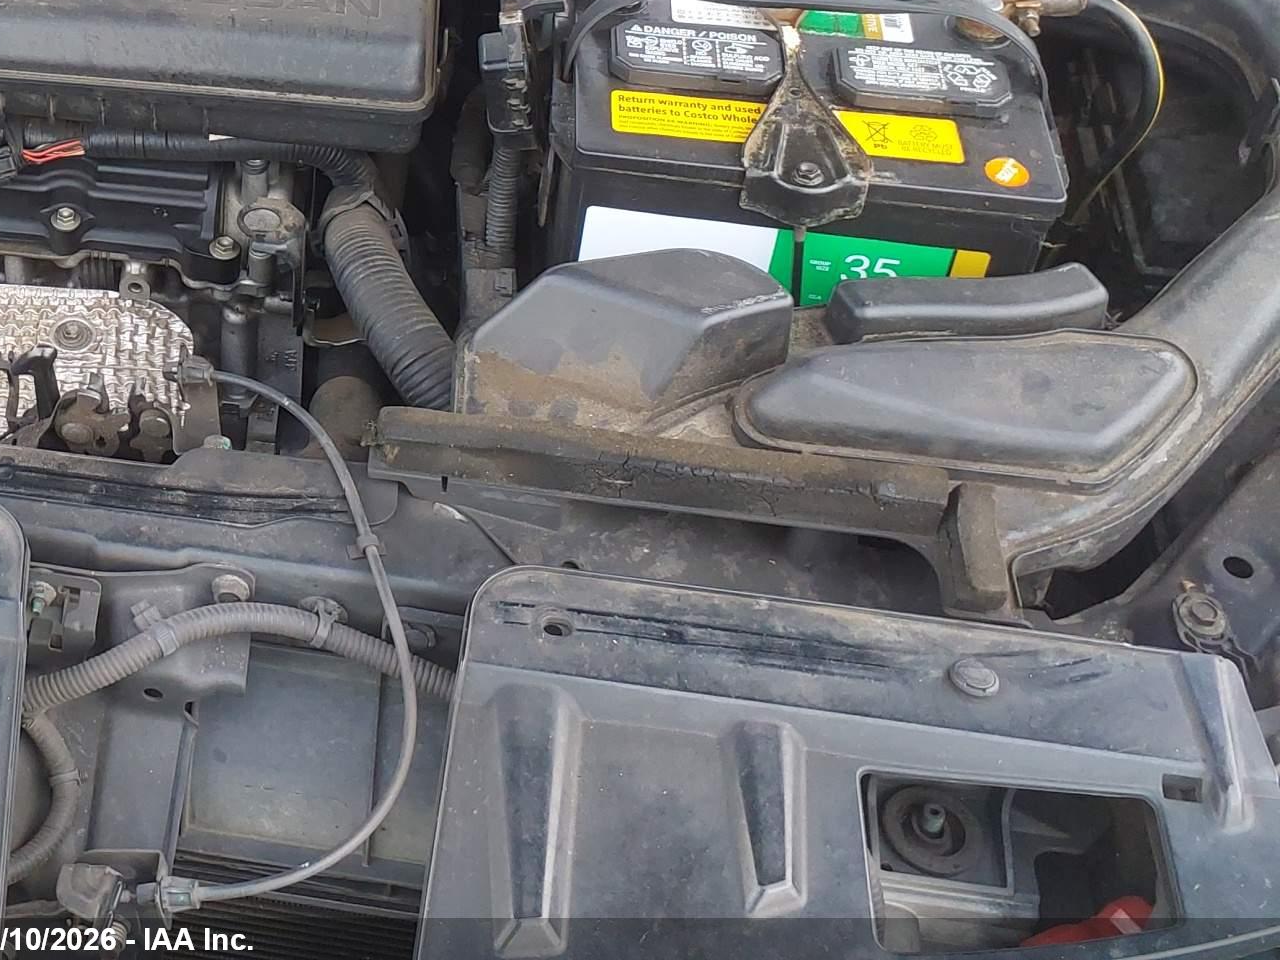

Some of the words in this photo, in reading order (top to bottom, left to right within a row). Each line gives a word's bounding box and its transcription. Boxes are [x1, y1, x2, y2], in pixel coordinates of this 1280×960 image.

[643, 25, 697, 38] DANGER
[708, 31, 758, 43] POISON
[617, 94, 656, 105] Return
[658, 98, 708, 112] warranty
[710, 102, 732, 112] and
[734, 105, 762, 115] used
[618, 104, 667, 116] batteries
[670, 108, 681, 117] to
[683, 110, 719, 121] Costco
[872, 142, 888, 150] Pb
[840, 254, 901, 279] 35
